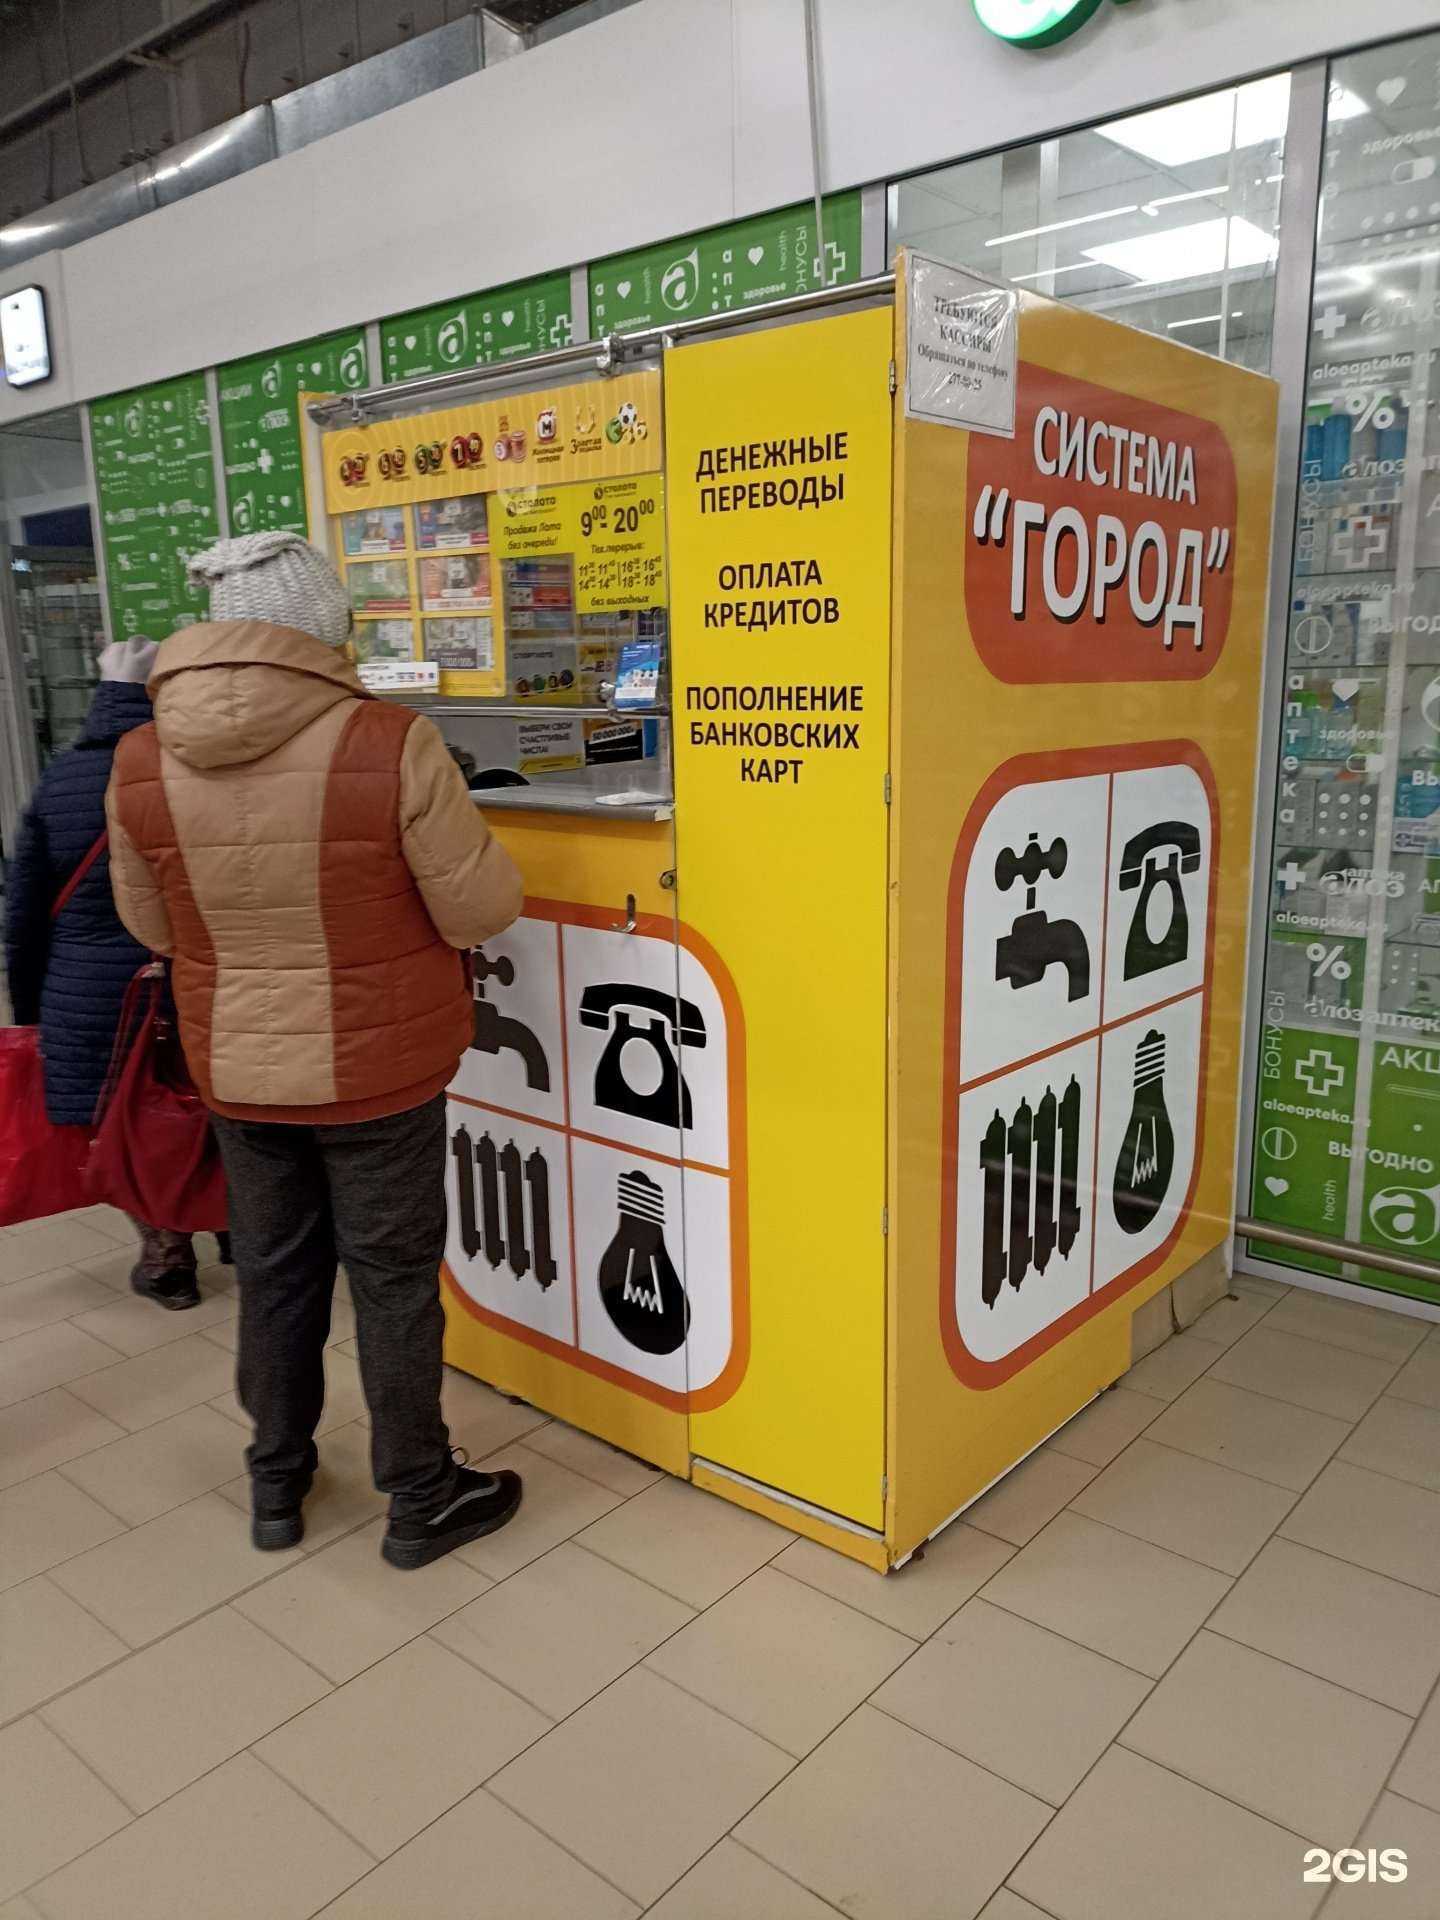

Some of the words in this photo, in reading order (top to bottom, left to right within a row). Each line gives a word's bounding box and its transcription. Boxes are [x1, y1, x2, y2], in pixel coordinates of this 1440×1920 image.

[696, 432, 848, 482] ДЕНЕЖНЫЕ
[1034, 406, 1196, 505] СИСТЕМА
[700, 473, 844, 514] ПЕРЕВОДЫ
[718, 559, 822, 591] ОПЛАТА
[704, 597, 840, 632] КРЕДИТОВ
[686, 686, 863, 713] ПОПОЛНЕНИЕ
[690, 721, 860, 749] БАНКОВСКИХ
[740, 758, 803, 784] КАРТ
[1264, 991, 1285, 1079] БОНУСЫ
[1323, 1179, 1337, 1222] health
